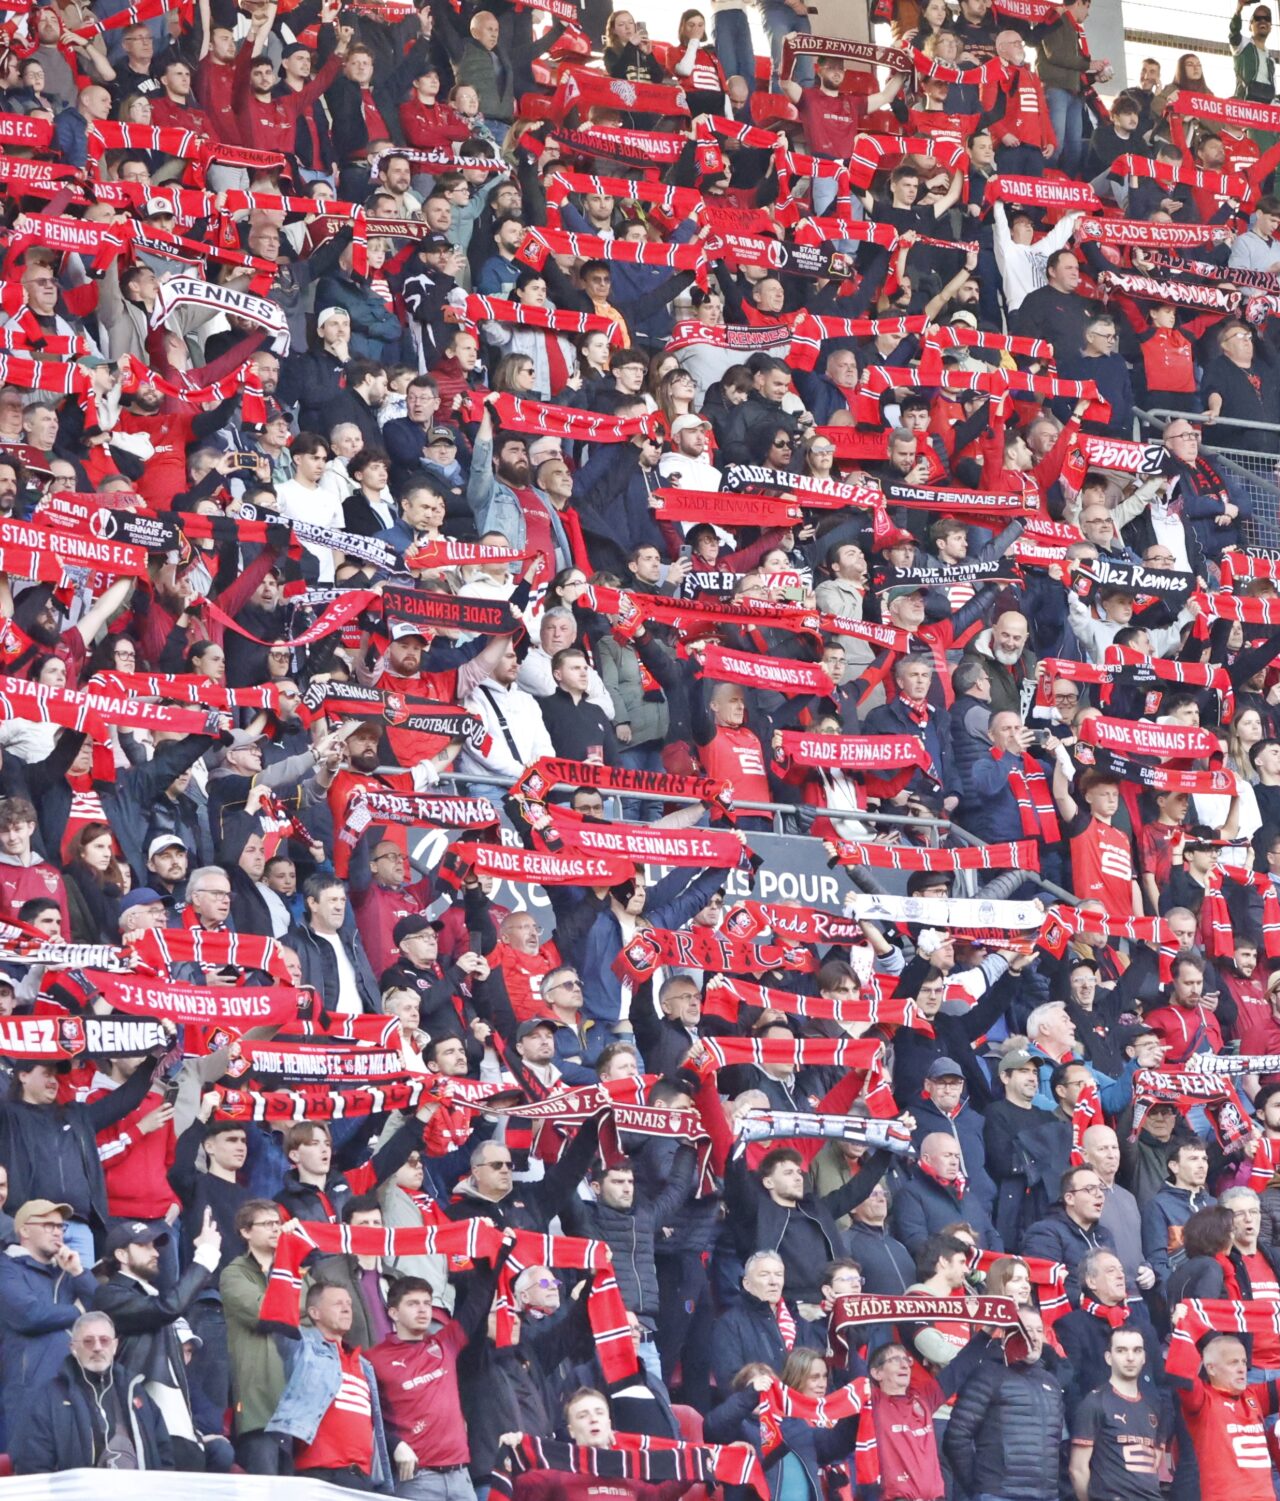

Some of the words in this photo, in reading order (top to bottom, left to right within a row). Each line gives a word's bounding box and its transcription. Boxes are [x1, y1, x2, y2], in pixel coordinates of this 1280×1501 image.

[789, 37, 823, 55] STADE
[826, 42, 873, 61] RENNAIS
[1191, 97, 1223, 115] STADE
[1225, 103, 1269, 124] RENNAIS
[17, 122, 37, 138] F.C.
[1001, 178, 1031, 198] STADE
[1035, 182, 1081, 202] RENNAIS
[45, 224, 98, 246] RENNAIS
[799, 246, 821, 258] STADE
[173, 281, 273, 320] RENNES
[727, 326, 789, 345] RENNES
[728, 464, 775, 491] STADE
[853, 486, 879, 507] F.C.
[890, 485, 925, 499] STADE
[927, 489, 995, 505] RENNAIS
[998, 494, 1021, 507] F.C.
[53, 498, 88, 518] MILAN
[124, 522, 158, 537] RENNAIS
[160, 529, 173, 540] FC
[135, 517, 164, 530] STADE
[1055, 522, 1077, 541] F.C.
[2, 524, 47, 549] STADE
[50, 536, 110, 562] RENNAIS
[113, 549, 138, 567] F.C.
[447, 541, 477, 560] ALLEZ
[1022, 543, 1067, 560] RENNAIS
[1143, 566, 1189, 592] Rennes
[327, 603, 352, 621] F.C.
[722, 656, 754, 676] STADE
[755, 663, 797, 683] RENNAIS
[799, 670, 817, 686] F.C.
[332, 682, 380, 701] RENNAIS
[142, 702, 172, 721] F.C.
[408, 717, 460, 736] FOOTBALL
[1096, 720, 1132, 744] STADE
[1133, 725, 1185, 750] RENNAIS
[1188, 732, 1210, 750] F.C.
[800, 740, 837, 759] STADE
[839, 742, 892, 761] RENNAIS
[894, 745, 917, 761] F.C.
[548, 758, 601, 784] STADE
[609, 767, 687, 794] RENNAIS
[691, 777, 715, 797] FC
[1140, 767, 1168, 781] EUROPA
[416, 795, 496, 823] RENNAIS
[580, 832, 624, 850] STADE
[627, 836, 688, 856] RENNAIS
[691, 842, 718, 857] F.C.
[477, 849, 519, 871] STADE
[523, 856, 583, 877] RENNAIS
[586, 861, 613, 876] F.C.
[761, 873, 838, 903] POUR
[761, 905, 808, 935] Stade
[115, 983, 144, 1007] F.C.
[150, 991, 217, 1017] RENNAIS
[221, 995, 271, 1017] STADE
[86, 1019, 166, 1051] RENNES
[252, 1050, 281, 1074] STADE
[283, 1051, 327, 1075] RENNAIS
[328, 1052, 343, 1075] F.C.
[354, 1051, 367, 1074] AC
[368, 1050, 400, 1074] MILAN
[614, 1108, 666, 1129] ENNAIS
[844, 1299, 892, 1318] STADE
[895, 1300, 964, 1316] RENNAIS
[985, 1302, 1012, 1320] F.C.
